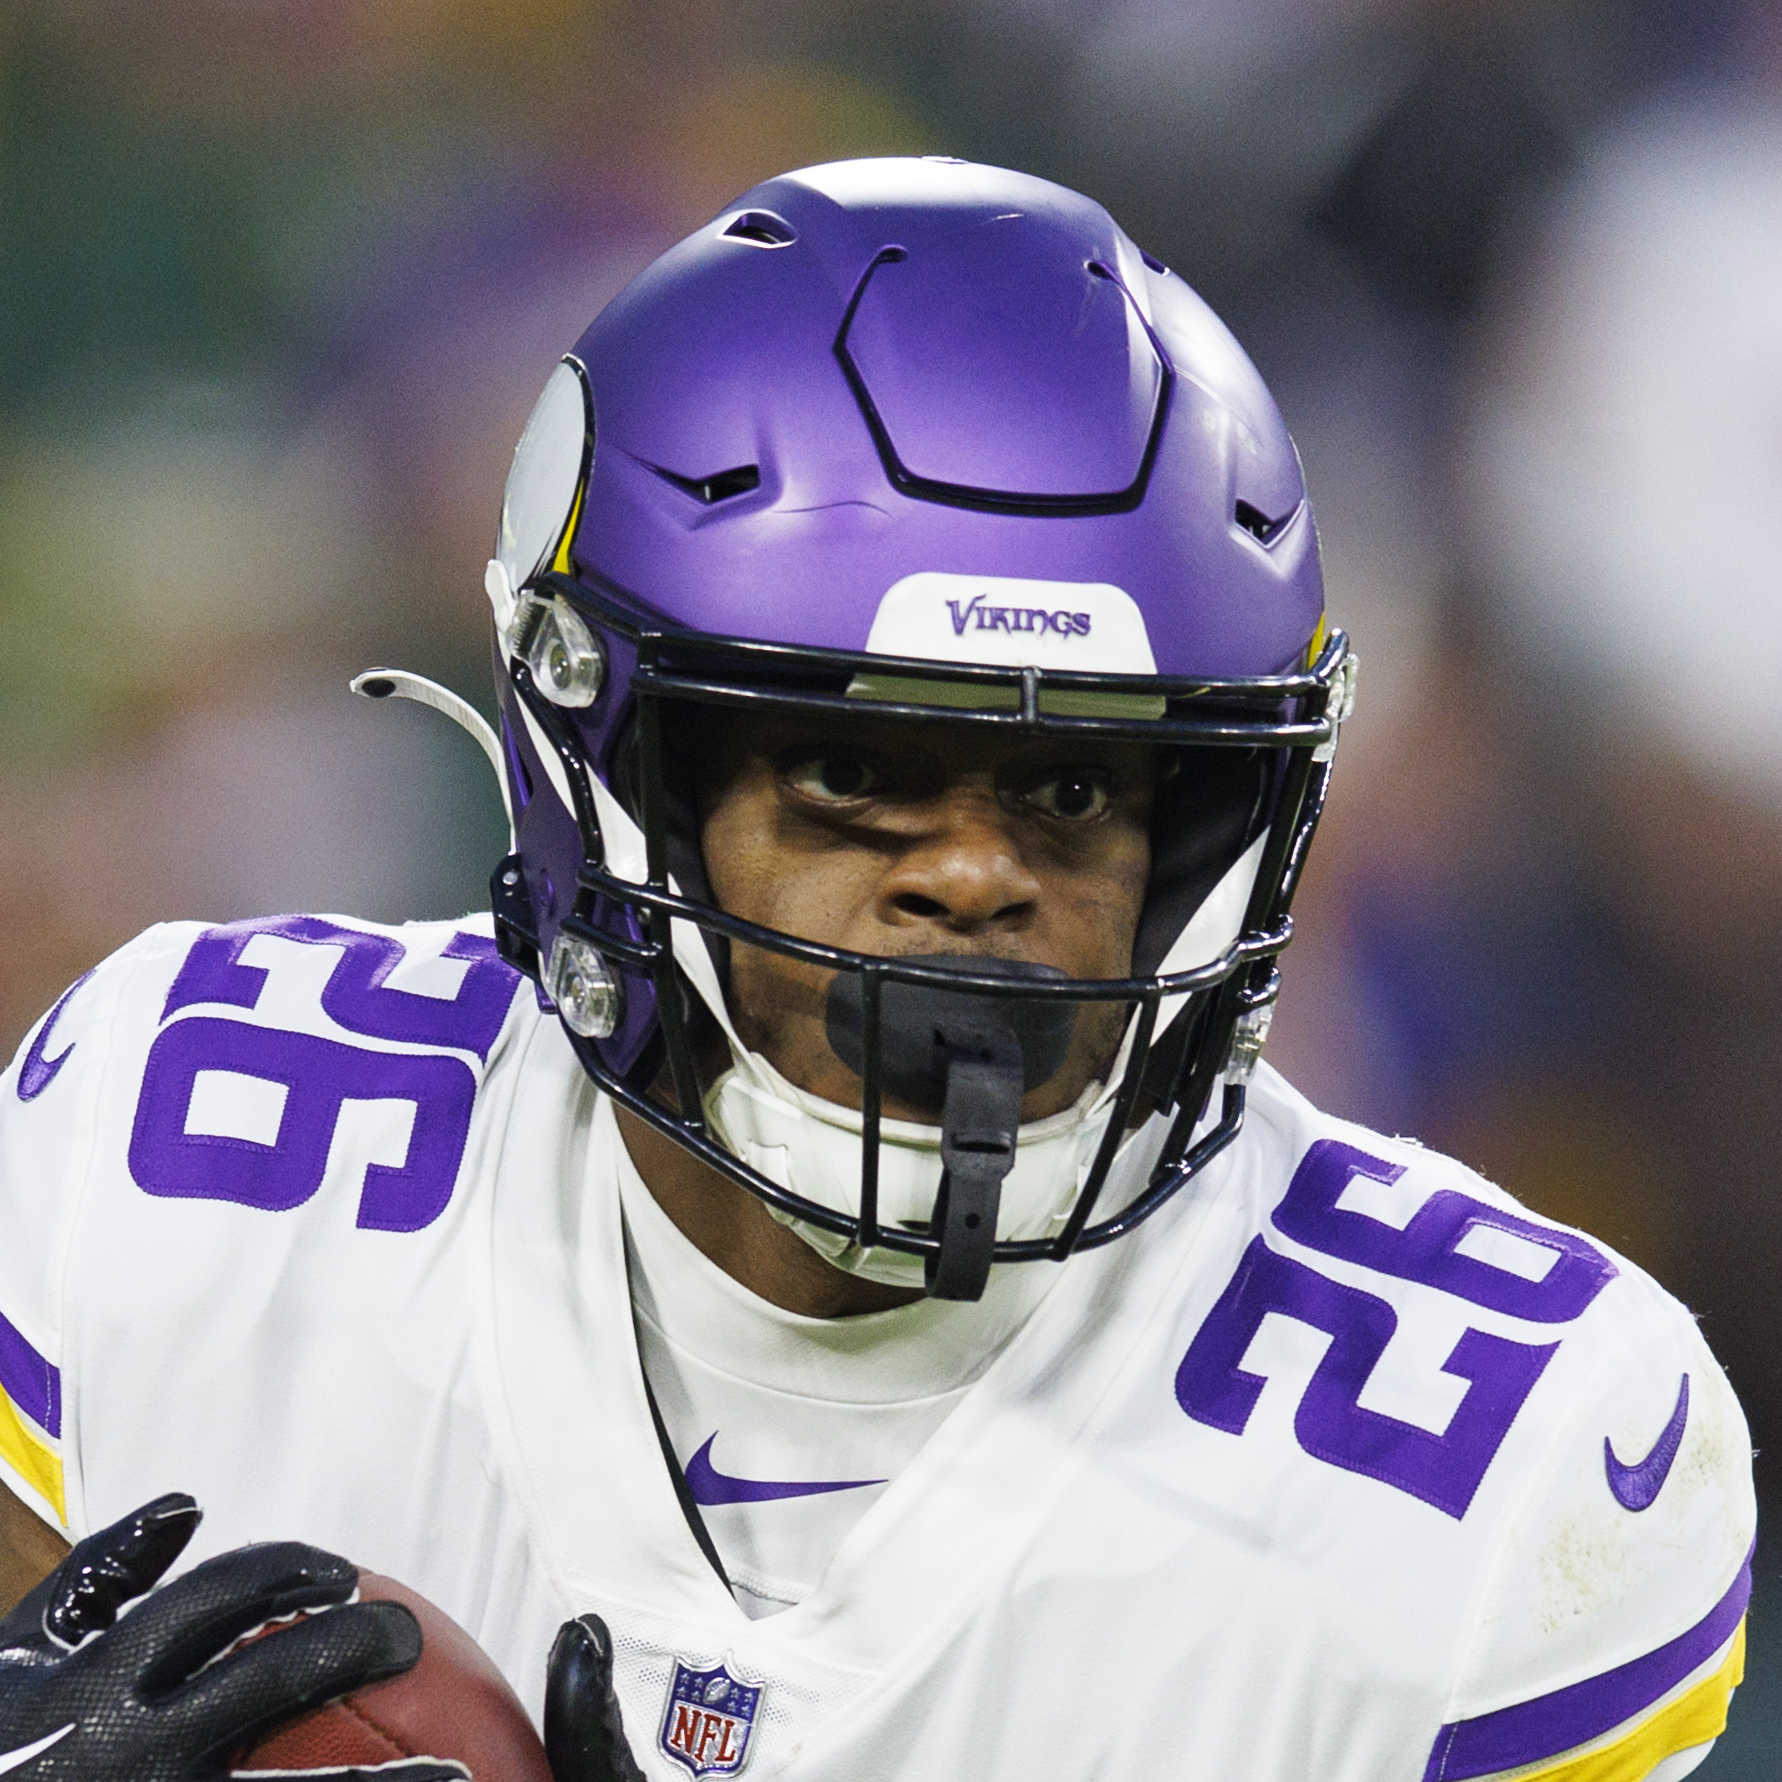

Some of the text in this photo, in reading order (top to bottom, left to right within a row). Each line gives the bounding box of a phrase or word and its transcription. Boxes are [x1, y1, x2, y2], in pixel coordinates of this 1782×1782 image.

[128, 914, 525, 1233] 26
[1175, 1138, 1621, 1522] 26
[670, 1705, 738, 1763] NFL
